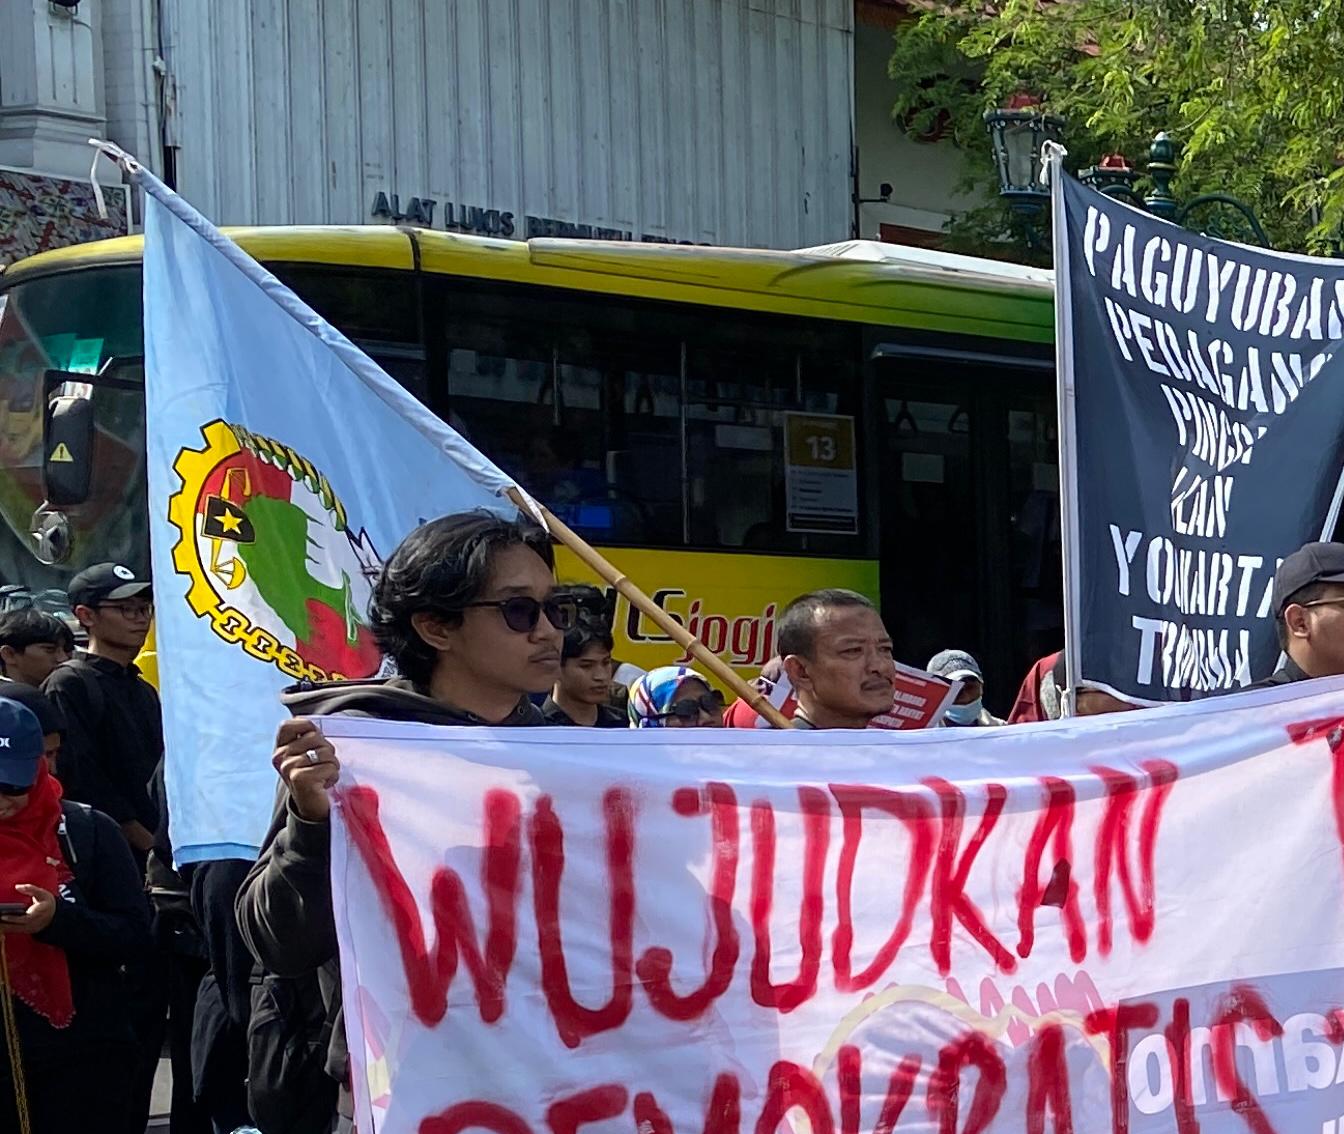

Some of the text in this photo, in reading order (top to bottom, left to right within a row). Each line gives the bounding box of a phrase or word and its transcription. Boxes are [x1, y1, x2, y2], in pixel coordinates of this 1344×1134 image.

[371, 192, 437, 225] ALAT
[445, 202, 515, 237] LUKIS
[805, 435, 836, 461] 13
[335, 760, 1180, 1048] WUJUDKAN
